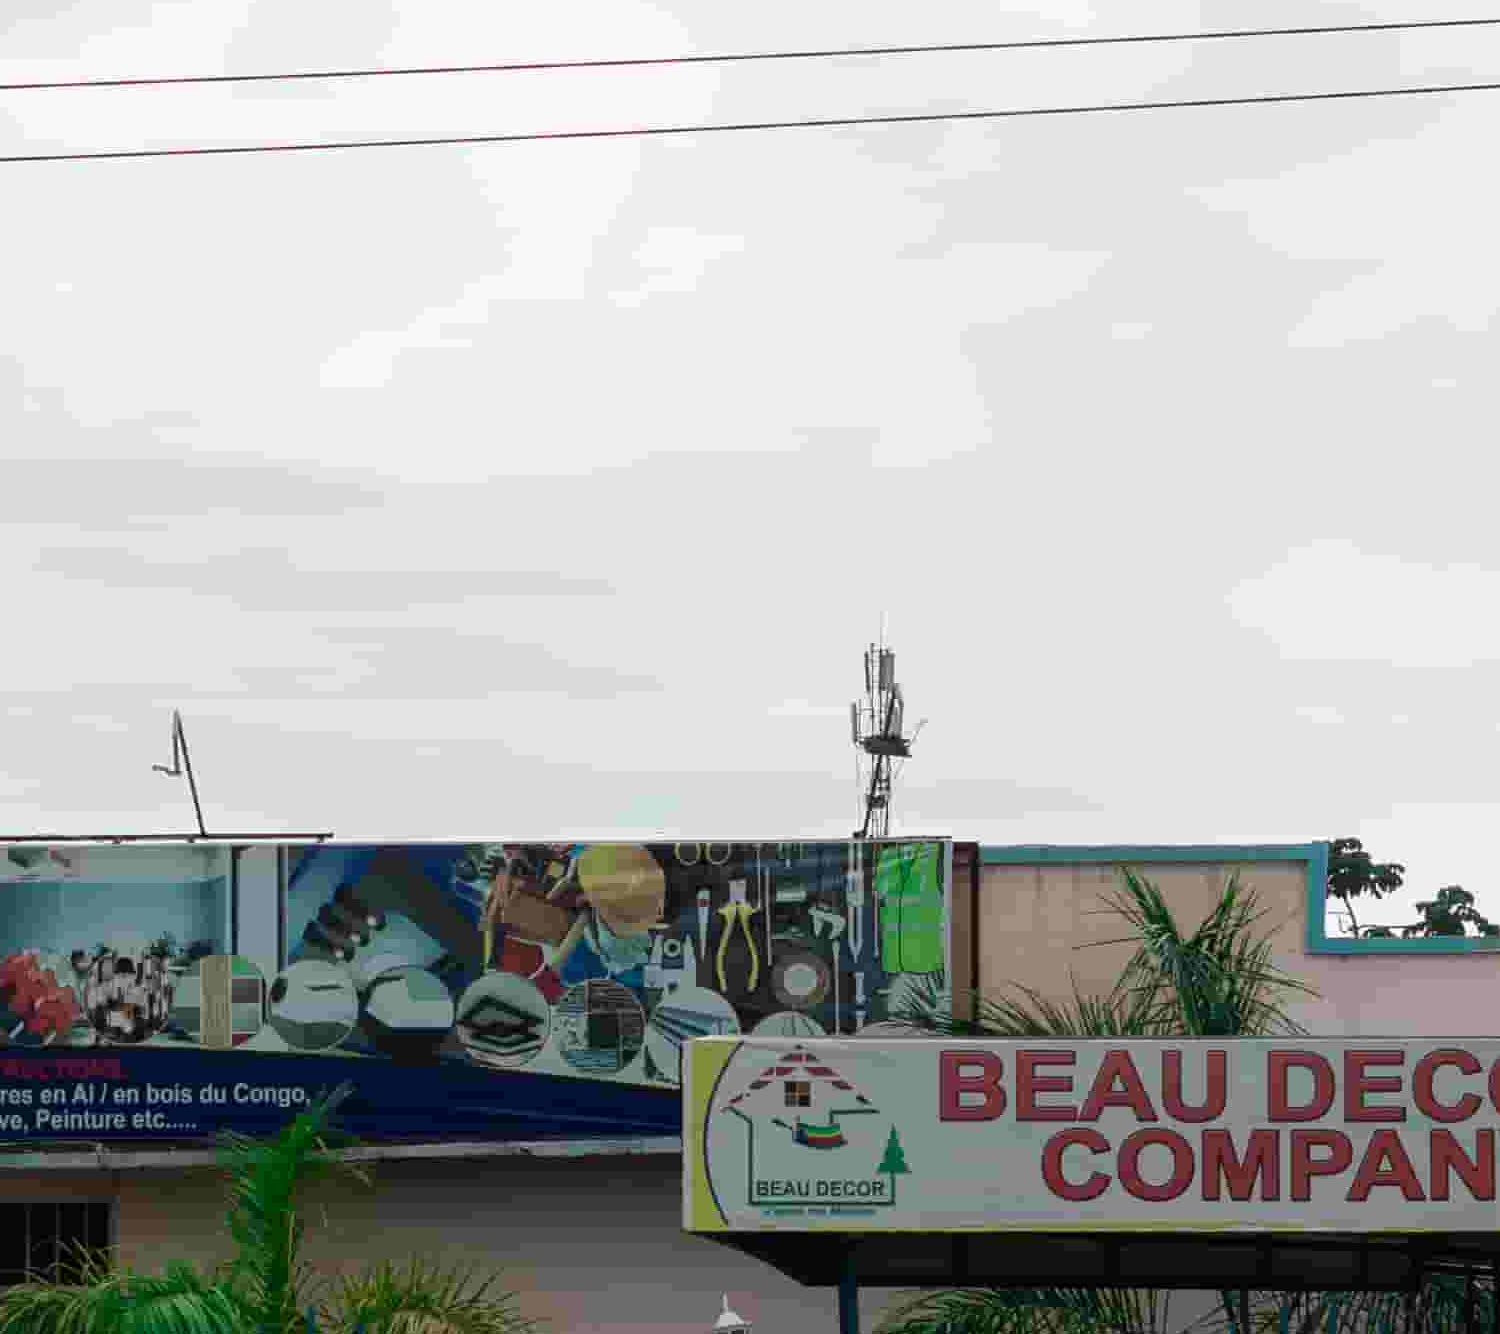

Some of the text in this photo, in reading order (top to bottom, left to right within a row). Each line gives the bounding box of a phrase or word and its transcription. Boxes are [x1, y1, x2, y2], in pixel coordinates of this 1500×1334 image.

[39, 1088, 66, 1105] en
[112, 1087, 140, 1104] en
[145, 1083, 193, 1104] bois
[199, 1083, 227, 1104] du
[232, 1083, 312, 1108] Congo,
[938, 1049, 1227, 1123] BEAU
[35, 1109, 127, 1130] Peinture
[756, 1179, 885, 1197] BEAU DECOR
